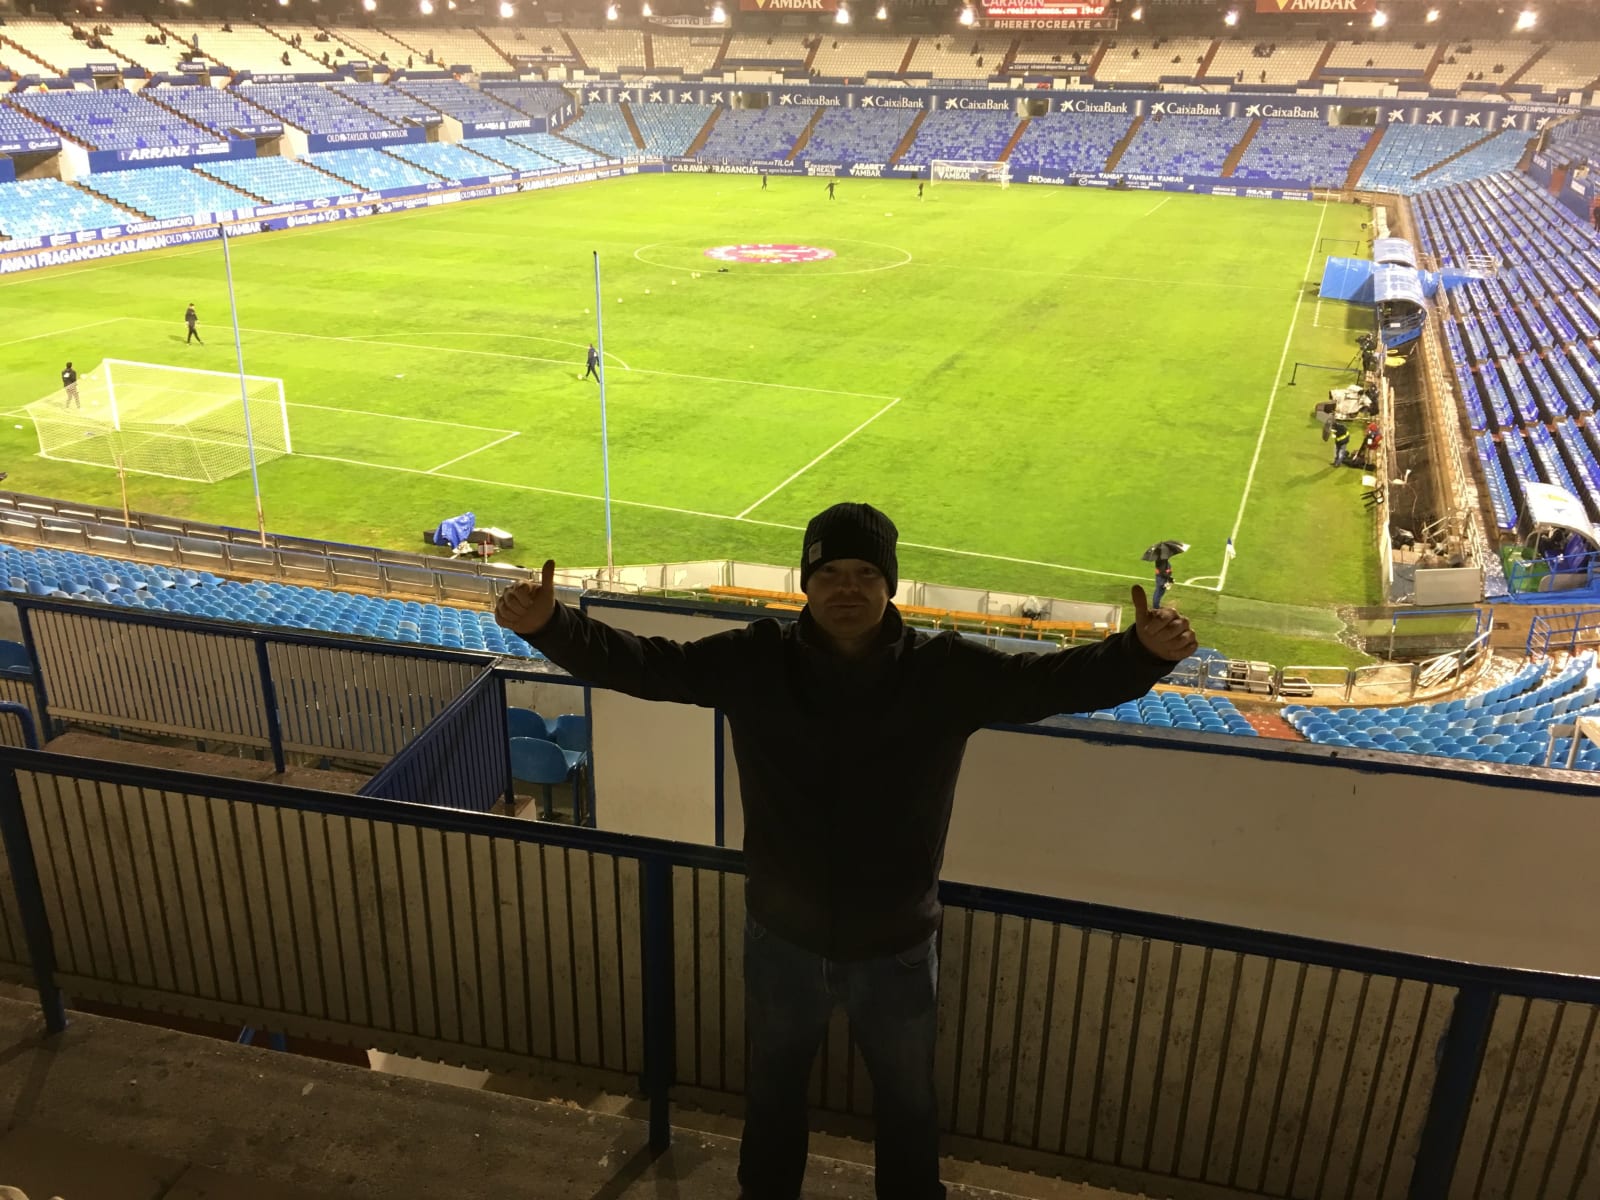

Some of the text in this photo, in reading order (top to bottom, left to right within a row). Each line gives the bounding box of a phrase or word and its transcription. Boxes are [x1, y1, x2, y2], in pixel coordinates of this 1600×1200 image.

[769, 0, 824, 9] AMBAR
[1290, 0, 1357, 10] AMBAR
[994, 20, 1091, 29] #HERETOCREATE
[793, 93, 841, 107] CaixaBank
[875, 95, 924, 109] CaixaBank
[959, 97, 1010, 111] CaixaBank
[1075, 100, 1128, 114] CaixaBank
[1167, 102, 1222, 116] CaixaBank
[1262, 104, 1320, 119] CaixaBank
[326, 132, 369, 143] OLD TAYLOR
[370, 129, 409, 140] OLD TAYLOR
[128, 145, 190, 160] ARRANZ
[774, 159, 795, 167] TILCA
[855, 169, 881, 177] AMBAR
[232, 221, 261, 236] AMBAR
[166, 228, 219, 245] OLD TAYLOR
[37, 243, 112, 267] FRAGANCIAS
[111, 234, 168, 255] CARAVAN
